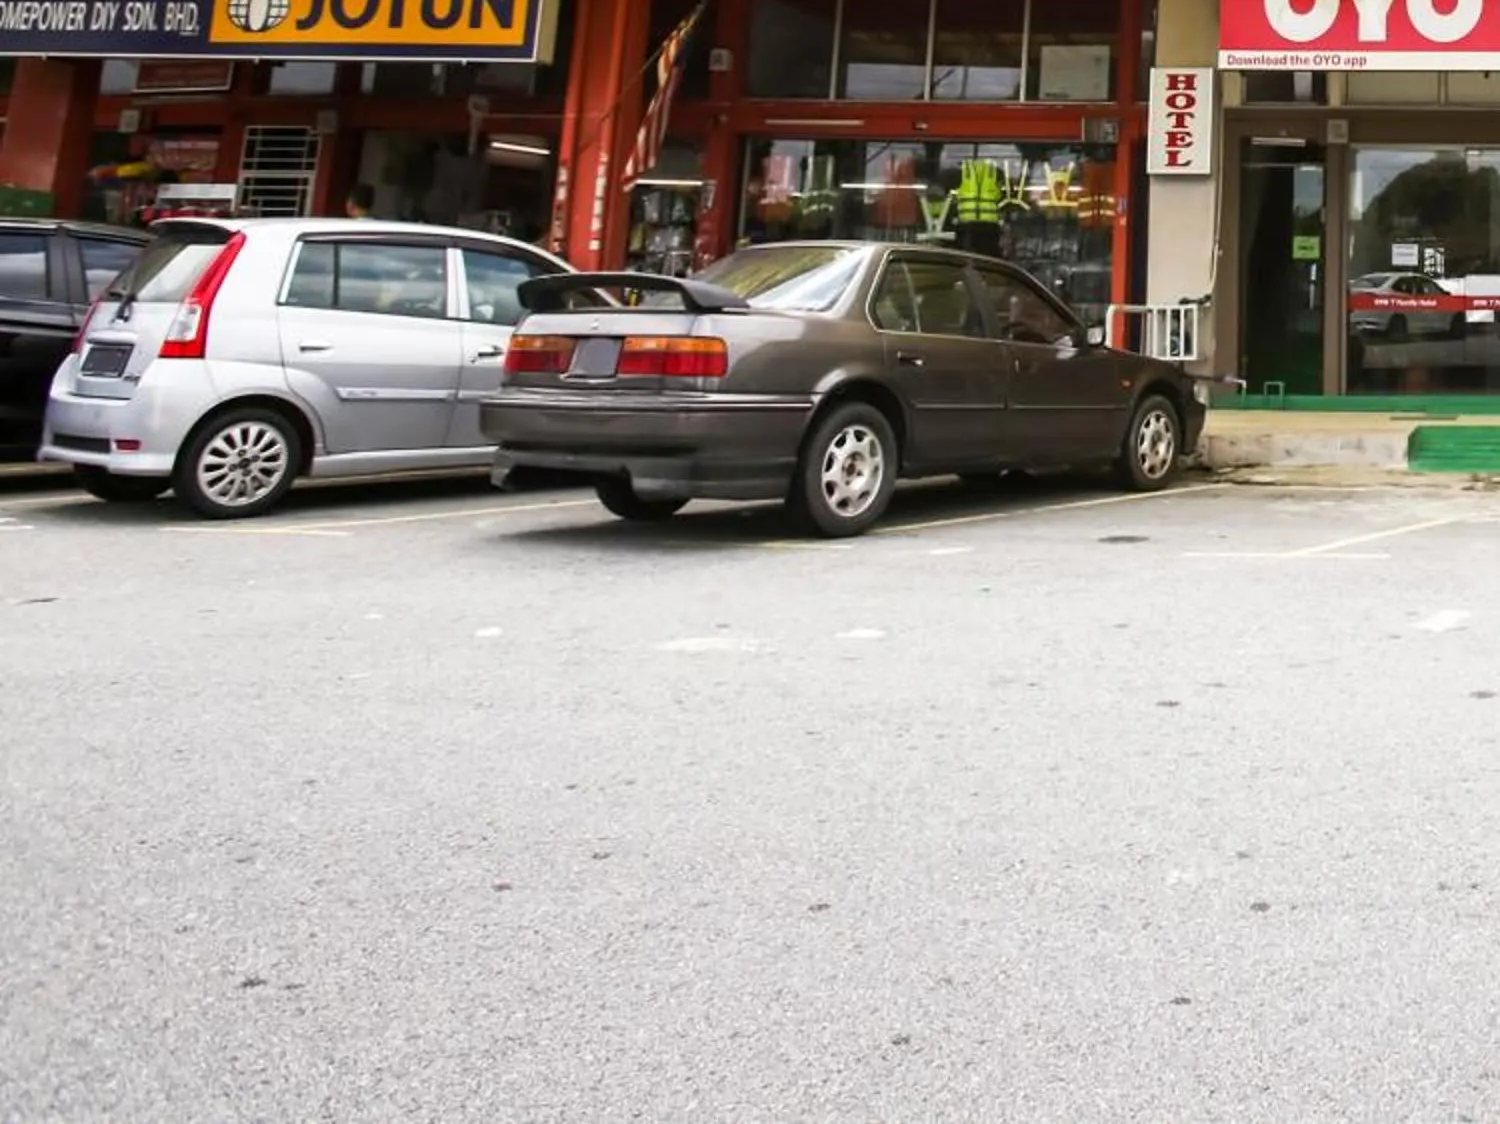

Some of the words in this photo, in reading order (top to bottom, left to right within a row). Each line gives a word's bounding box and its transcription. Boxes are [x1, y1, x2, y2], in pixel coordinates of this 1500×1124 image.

[90, 2, 120, 31] DIY
[1227, 55, 1287, 66] Download
[1290, 55, 1310, 66] the
[1312, 55, 1341, 66] OYO
[1343, 56, 1367, 68] app
[1164, 73, 1198, 167] HOTEL
